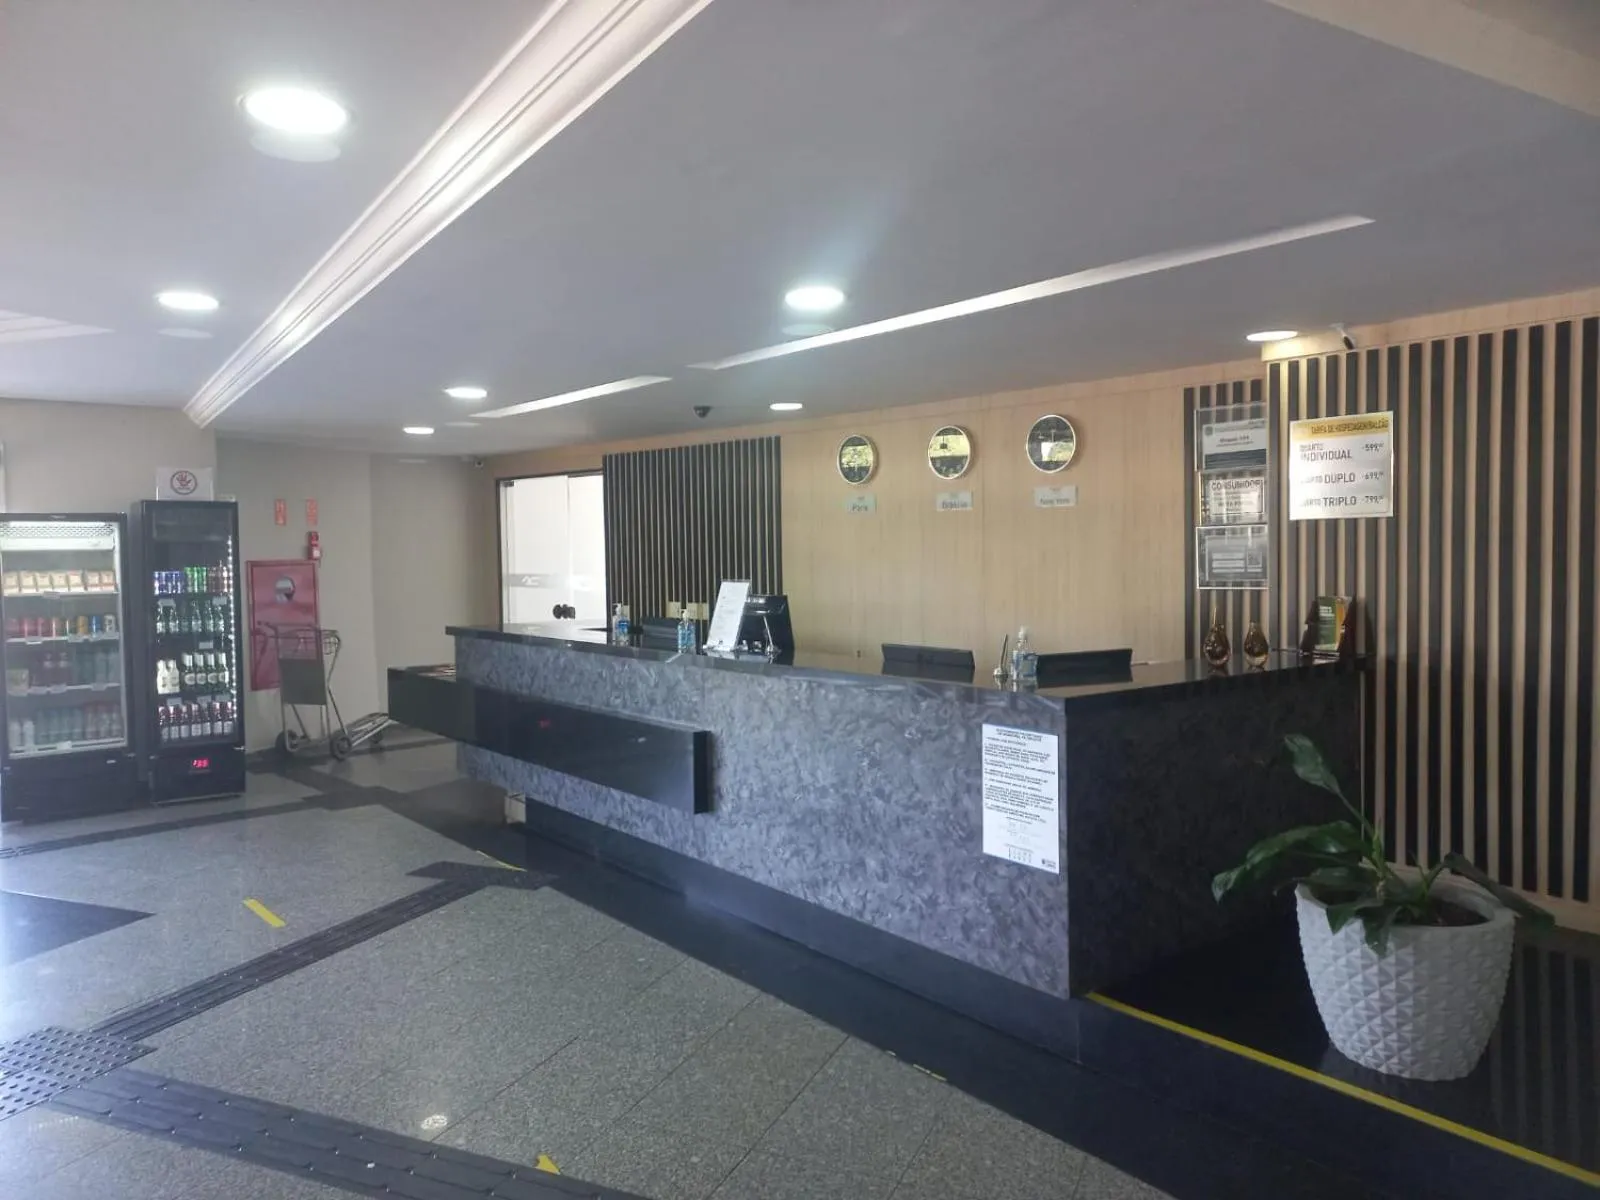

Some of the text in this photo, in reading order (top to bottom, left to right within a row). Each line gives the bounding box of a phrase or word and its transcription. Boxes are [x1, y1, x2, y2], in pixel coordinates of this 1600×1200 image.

[1300, 449, 1352, 462] INDIVIDUAL
[1324, 472, 1356, 484] DUPLO
[1323, 495, 1357, 507] TRIPLO
